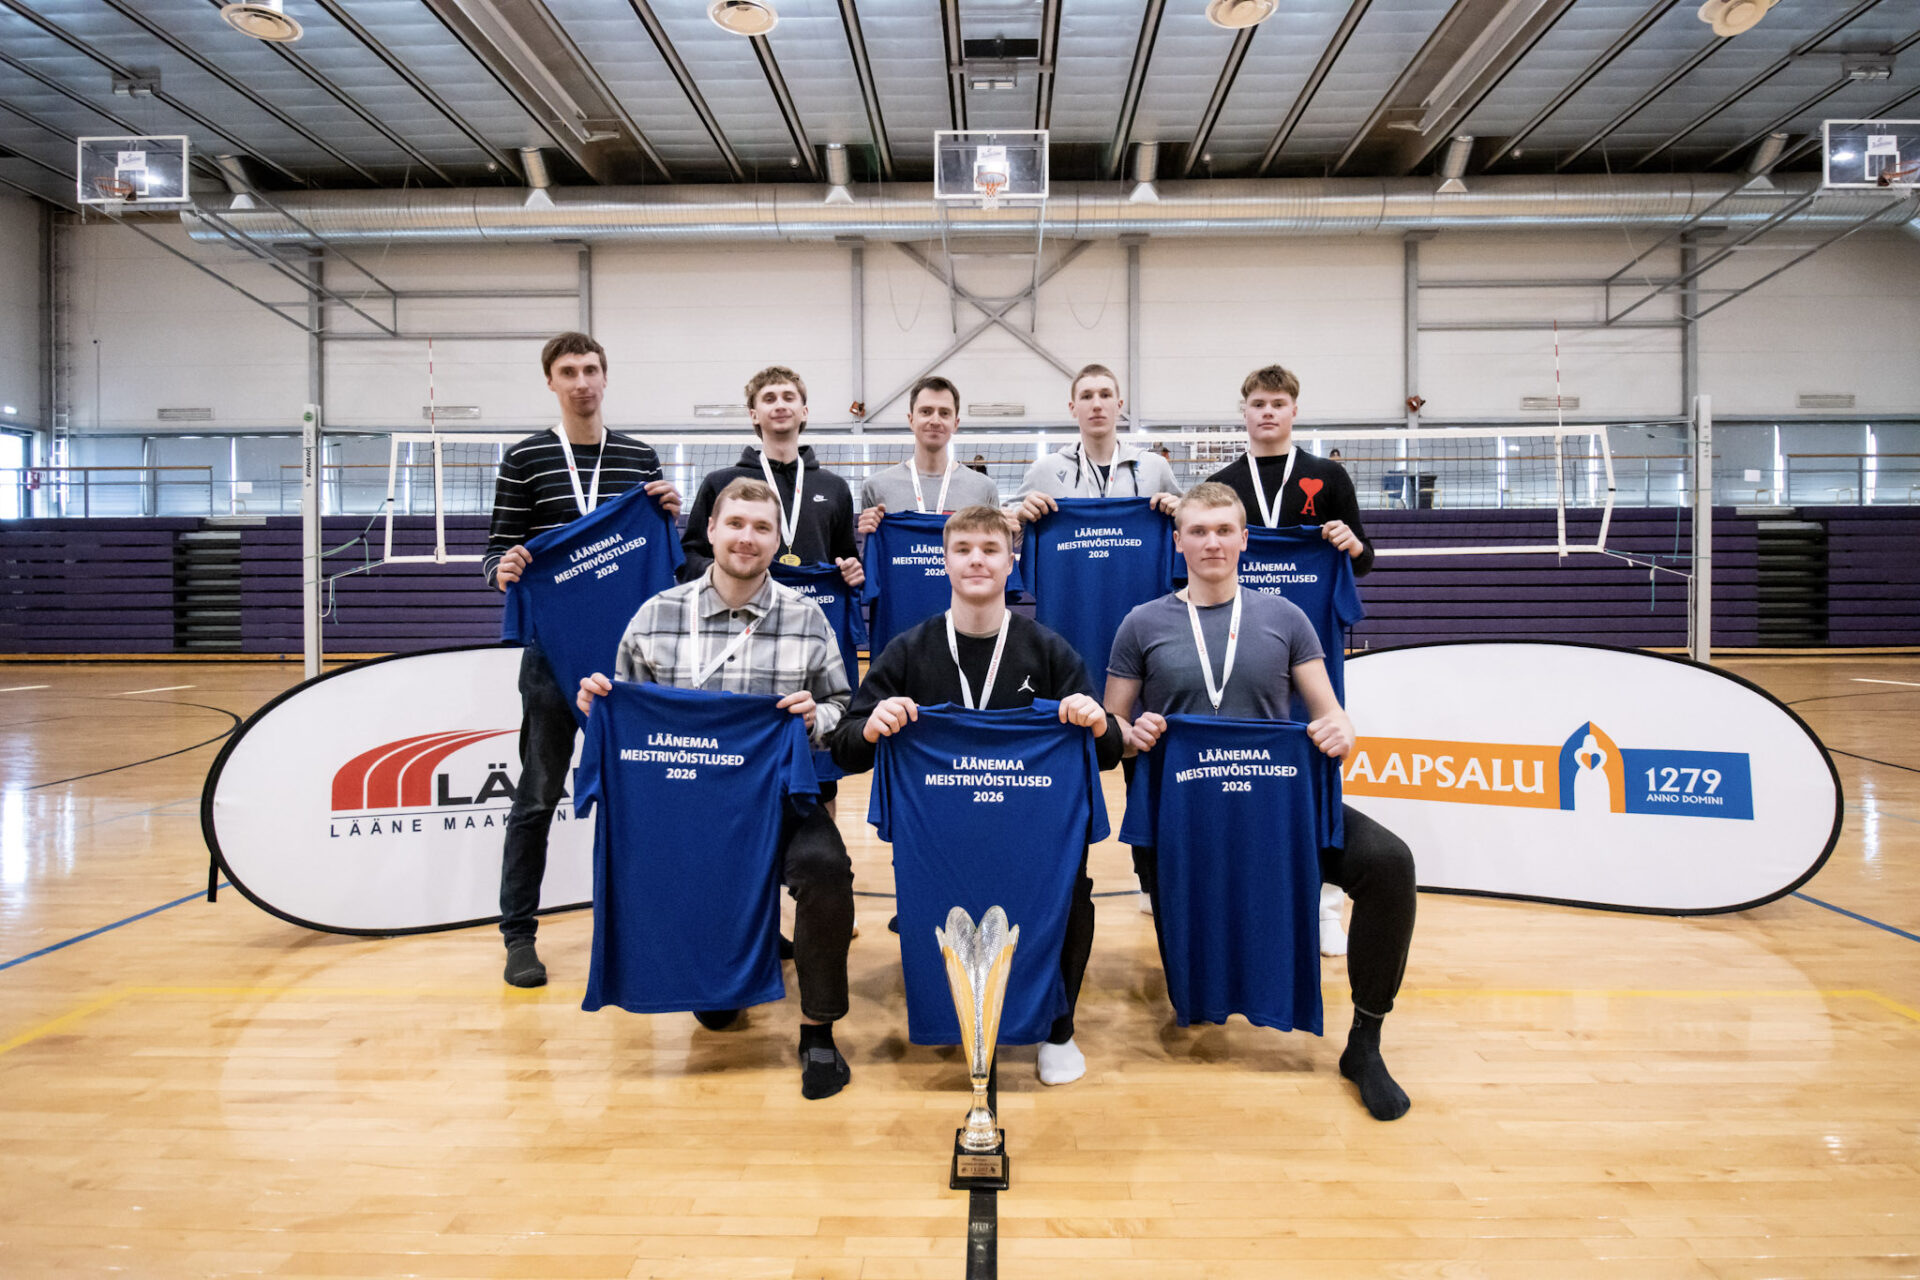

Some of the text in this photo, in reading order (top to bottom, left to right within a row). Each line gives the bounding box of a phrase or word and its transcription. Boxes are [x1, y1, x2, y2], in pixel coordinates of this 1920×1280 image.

[1075, 528, 1123, 538] LÄÄNEMAA
[569, 533, 623, 563] LÄÄNEMAA
[910, 545, 945, 554] LÄÄNEM
[1057, 538, 1142, 551] MEISTRIVÕISTLUSED
[554, 536, 647, 584] MEISTRIVÕISTLUSED
[892, 556, 946, 565] MEISTRIVÕIS
[1088, 550, 1110, 559] 2026
[595, 562, 619, 579] 2026
[925, 568, 946, 576] 2026
[1242, 561, 1297, 572] LÄÄNEMAA
[1238, 573, 1318, 583] STRIVÕISTLUSED
[648, 733, 719, 749] LÄÄNEMAA
[620, 749, 745, 766] MEISTRIVÕISTLUSED
[1198, 748, 1271, 762] LÄÄNEMAA
[952, 757, 1025, 771] LÄÄNEMAA
[666, 768, 697, 780] 2026
[1176, 763, 1298, 783] MEISTRIVÕISTLUSED
[1340, 751, 1545, 794] AAPSALU
[925, 773, 1053, 787] MEISTRIVÕISTLUSED
[1222, 781, 1252, 792] 2026
[1645, 767, 1722, 794] 1279
[973, 791, 1005, 802] 2026
[1646, 793, 1724, 805] ANNO DOMINI
[330, 819, 422, 838] LÄÄNE
